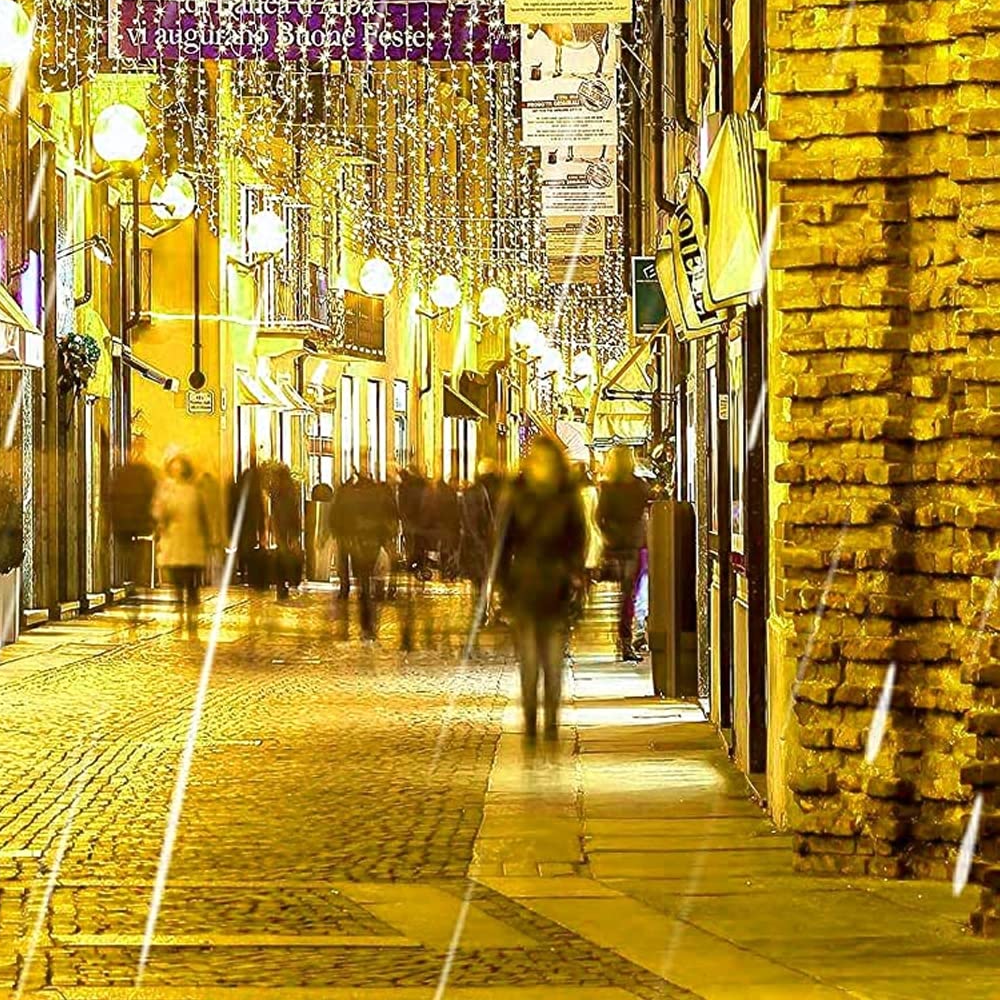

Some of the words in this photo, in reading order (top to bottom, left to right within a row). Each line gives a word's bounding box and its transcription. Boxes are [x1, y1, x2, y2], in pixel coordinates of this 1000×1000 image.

[126, 20, 148, 46] vi
[155, 27, 268, 54] augurano
[279, 21, 355, 47] Buone
